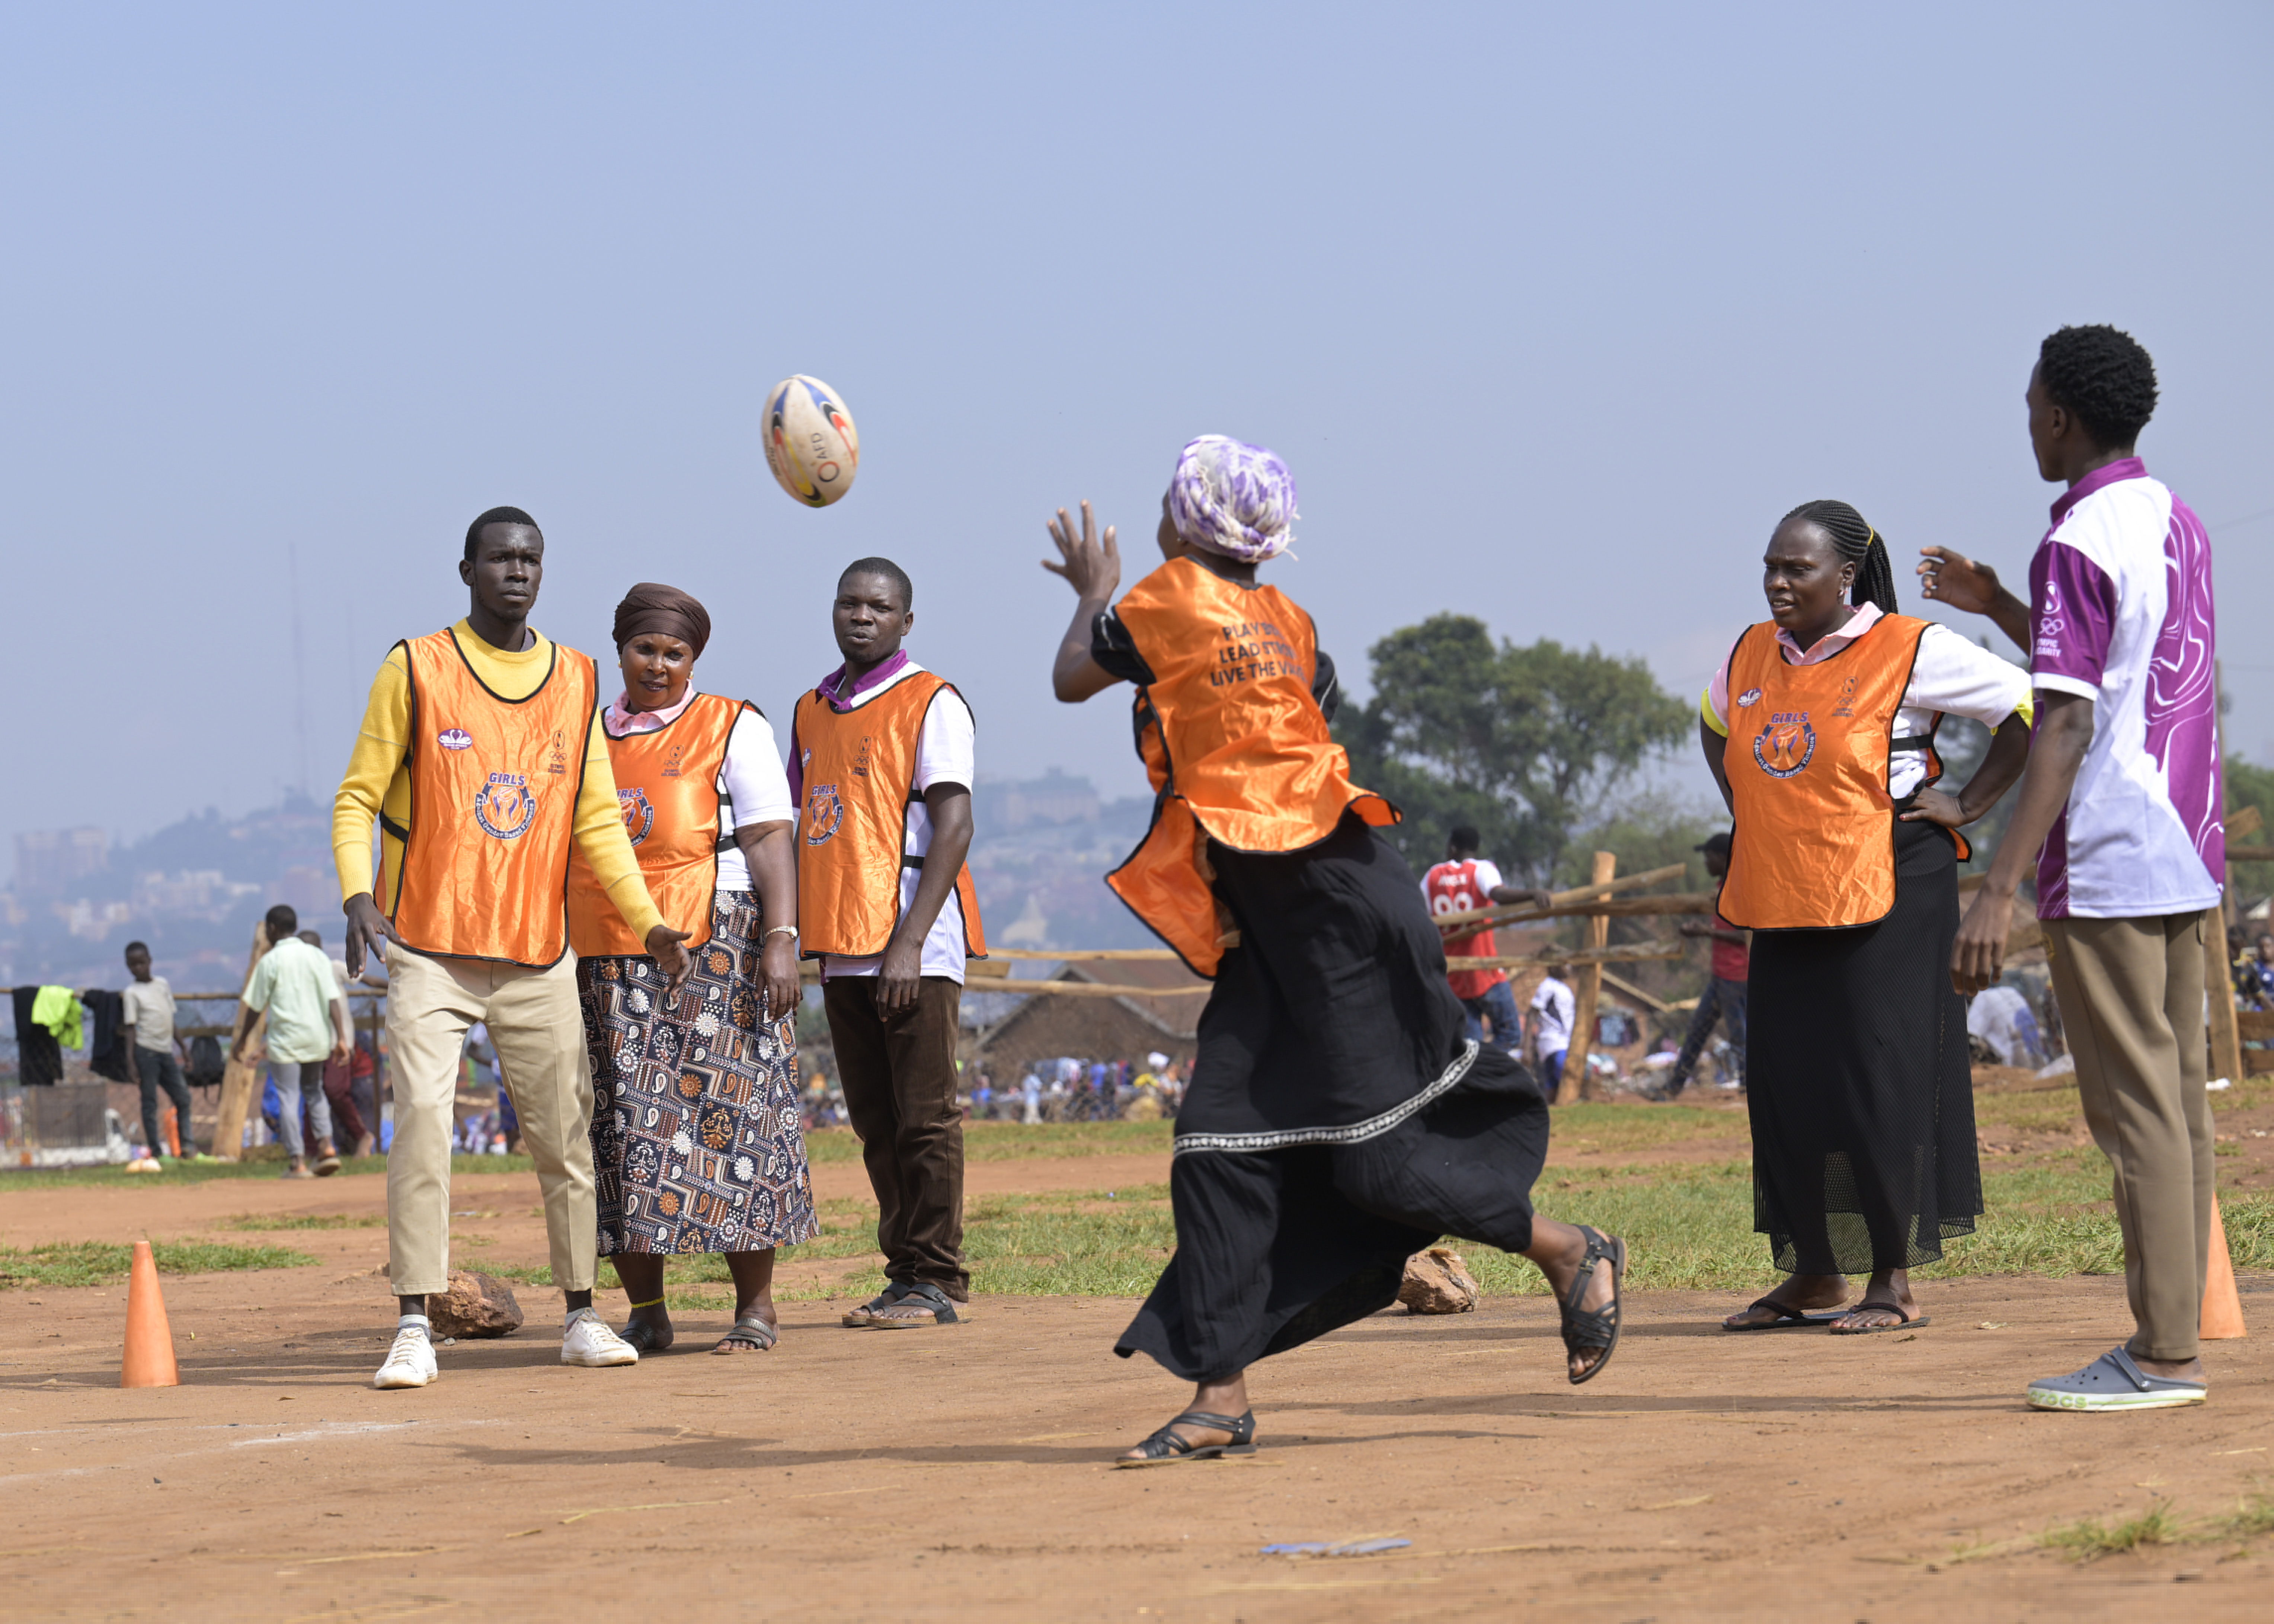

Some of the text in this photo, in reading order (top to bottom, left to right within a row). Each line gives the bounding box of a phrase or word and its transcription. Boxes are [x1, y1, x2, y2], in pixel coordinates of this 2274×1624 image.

[1222, 622, 1259, 641] PLAY
[2037, 637, 2059, 648] MPIC
[1219, 643, 1260, 664] LEAD
[2035, 647, 2062, 657] DARITY
[1210, 666, 1246, 686] LIVE
[1247, 661, 1276, 678] THE
[1771, 712, 1808, 723] GIRLS
[489, 772, 525, 786] GIRLS
[617, 788, 643, 798] IRLS
[812, 784, 837, 795] GIRLS
[2030, 1390, 2087, 1408] crocs
